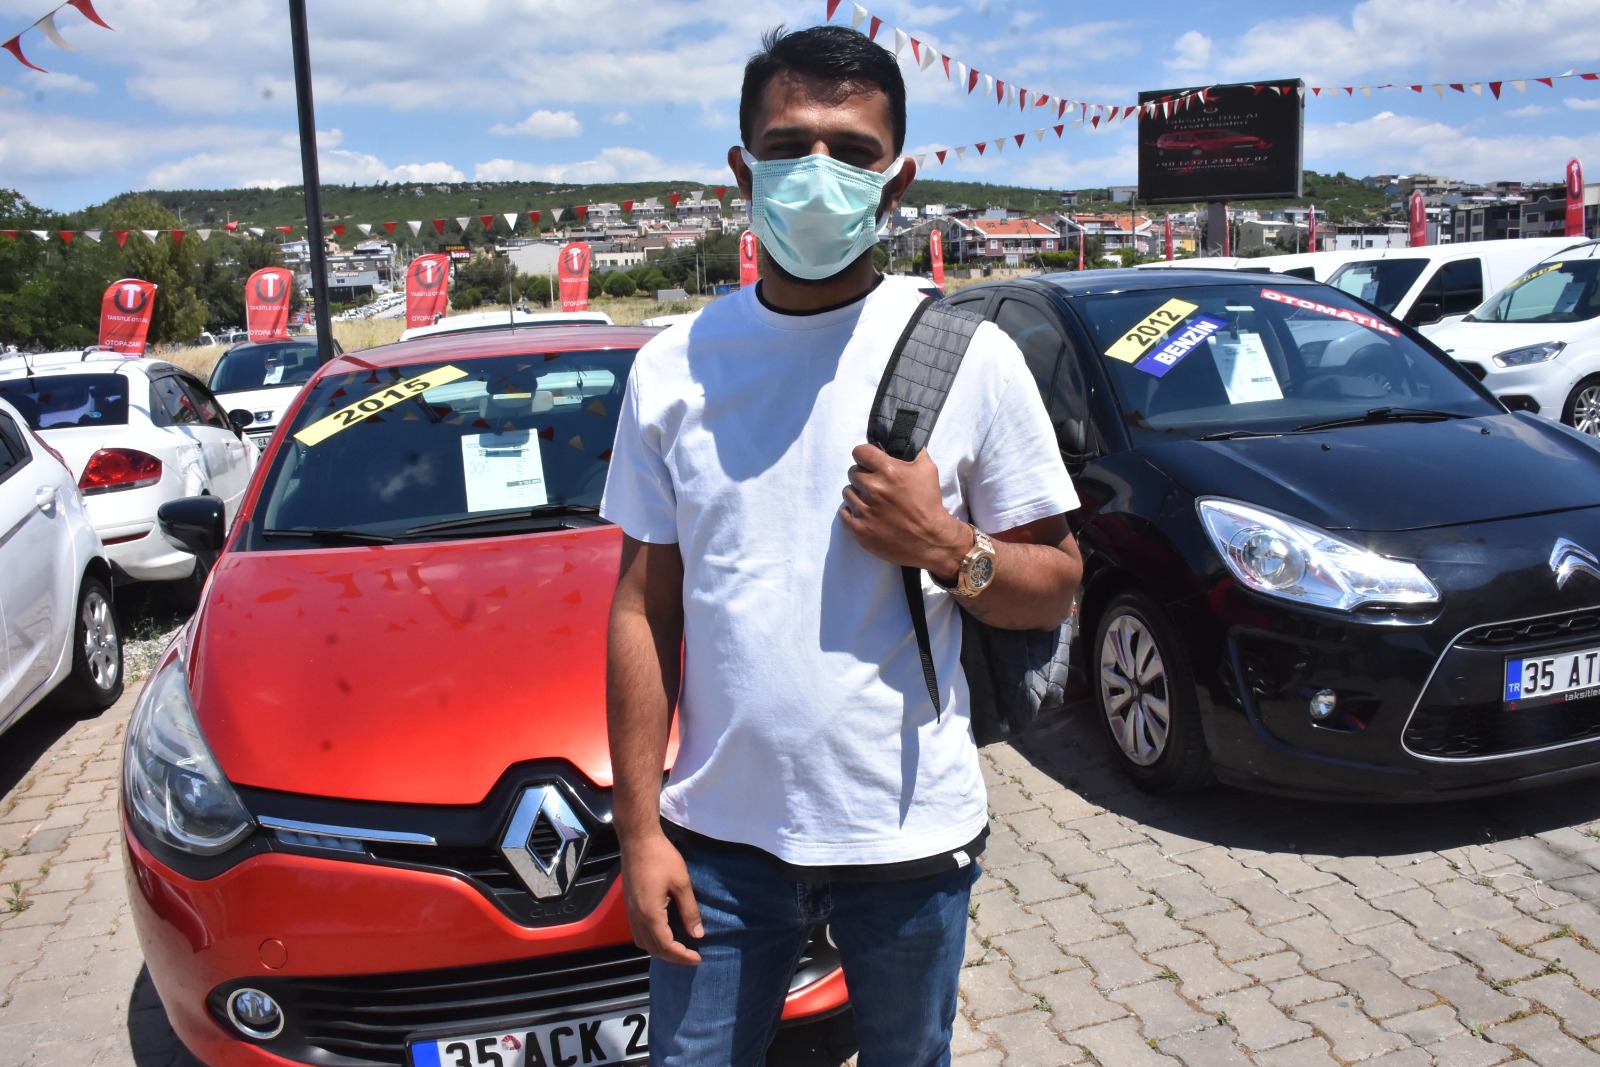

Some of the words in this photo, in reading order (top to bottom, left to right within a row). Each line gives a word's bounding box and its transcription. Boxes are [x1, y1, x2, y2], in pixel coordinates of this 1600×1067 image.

[1125, 310, 1181, 347] 2012
[1153, 319, 1219, 366] BENZİN
[333, 378, 431, 426] 2015
[1508, 682, 1521, 693] TR
[1523, 659, 1555, 694] 35
[1567, 652, 1600, 688] AT
[445, 1037, 504, 1067] 35
[523, 1020, 607, 1067] ACK
